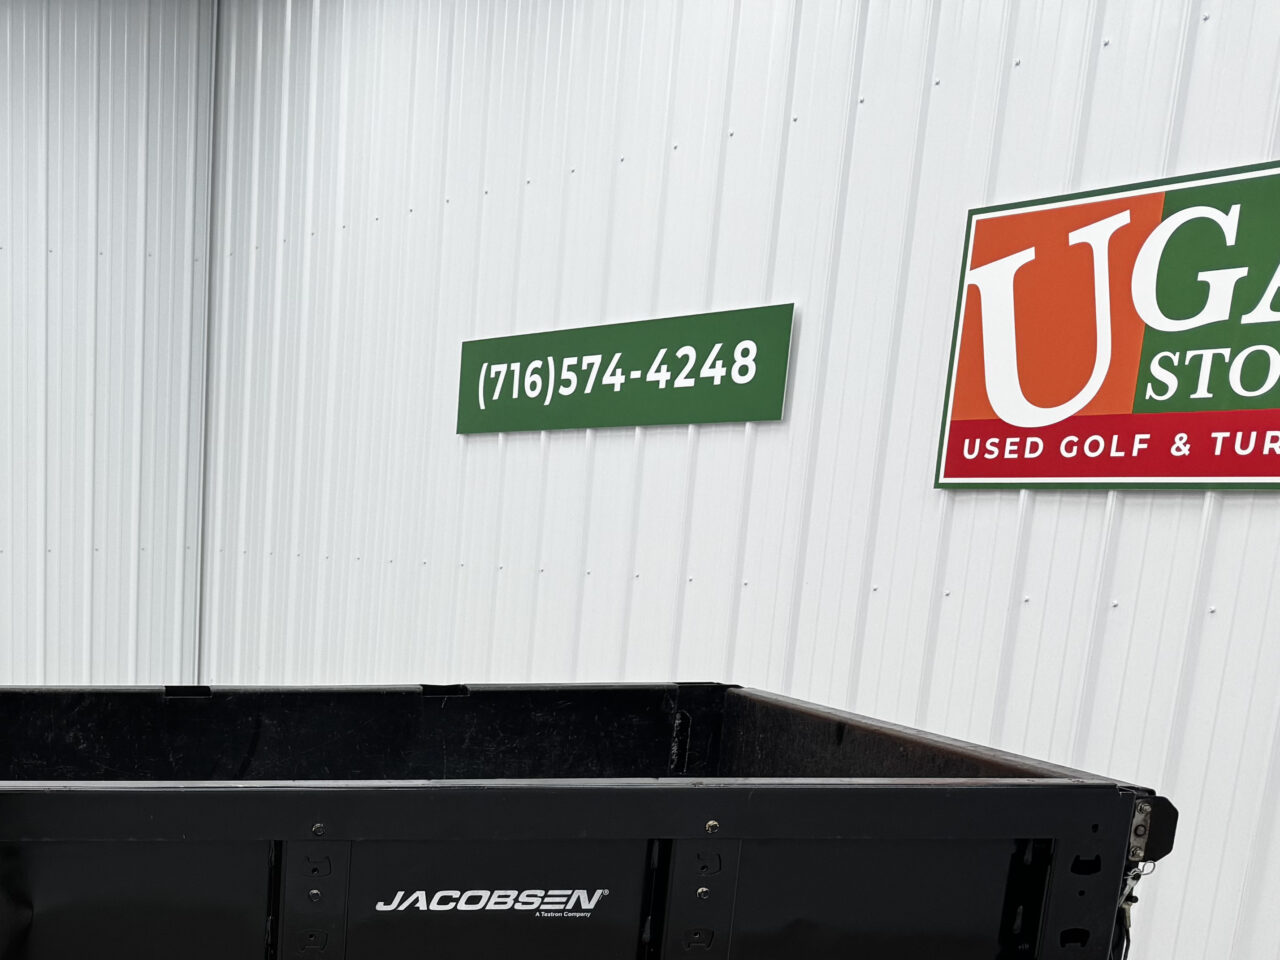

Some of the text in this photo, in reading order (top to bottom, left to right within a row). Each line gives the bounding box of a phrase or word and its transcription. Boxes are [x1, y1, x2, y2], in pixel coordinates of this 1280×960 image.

[477, 339, 758, 409] (716)574-4248
[1145, 345, 1280, 400] STO
[963, 437, 1044, 460] USED
[1060, 434, 1151, 458] GOLF
[1170, 433, 1191, 456] &
[375, 889, 604, 911] JACOBSEN
